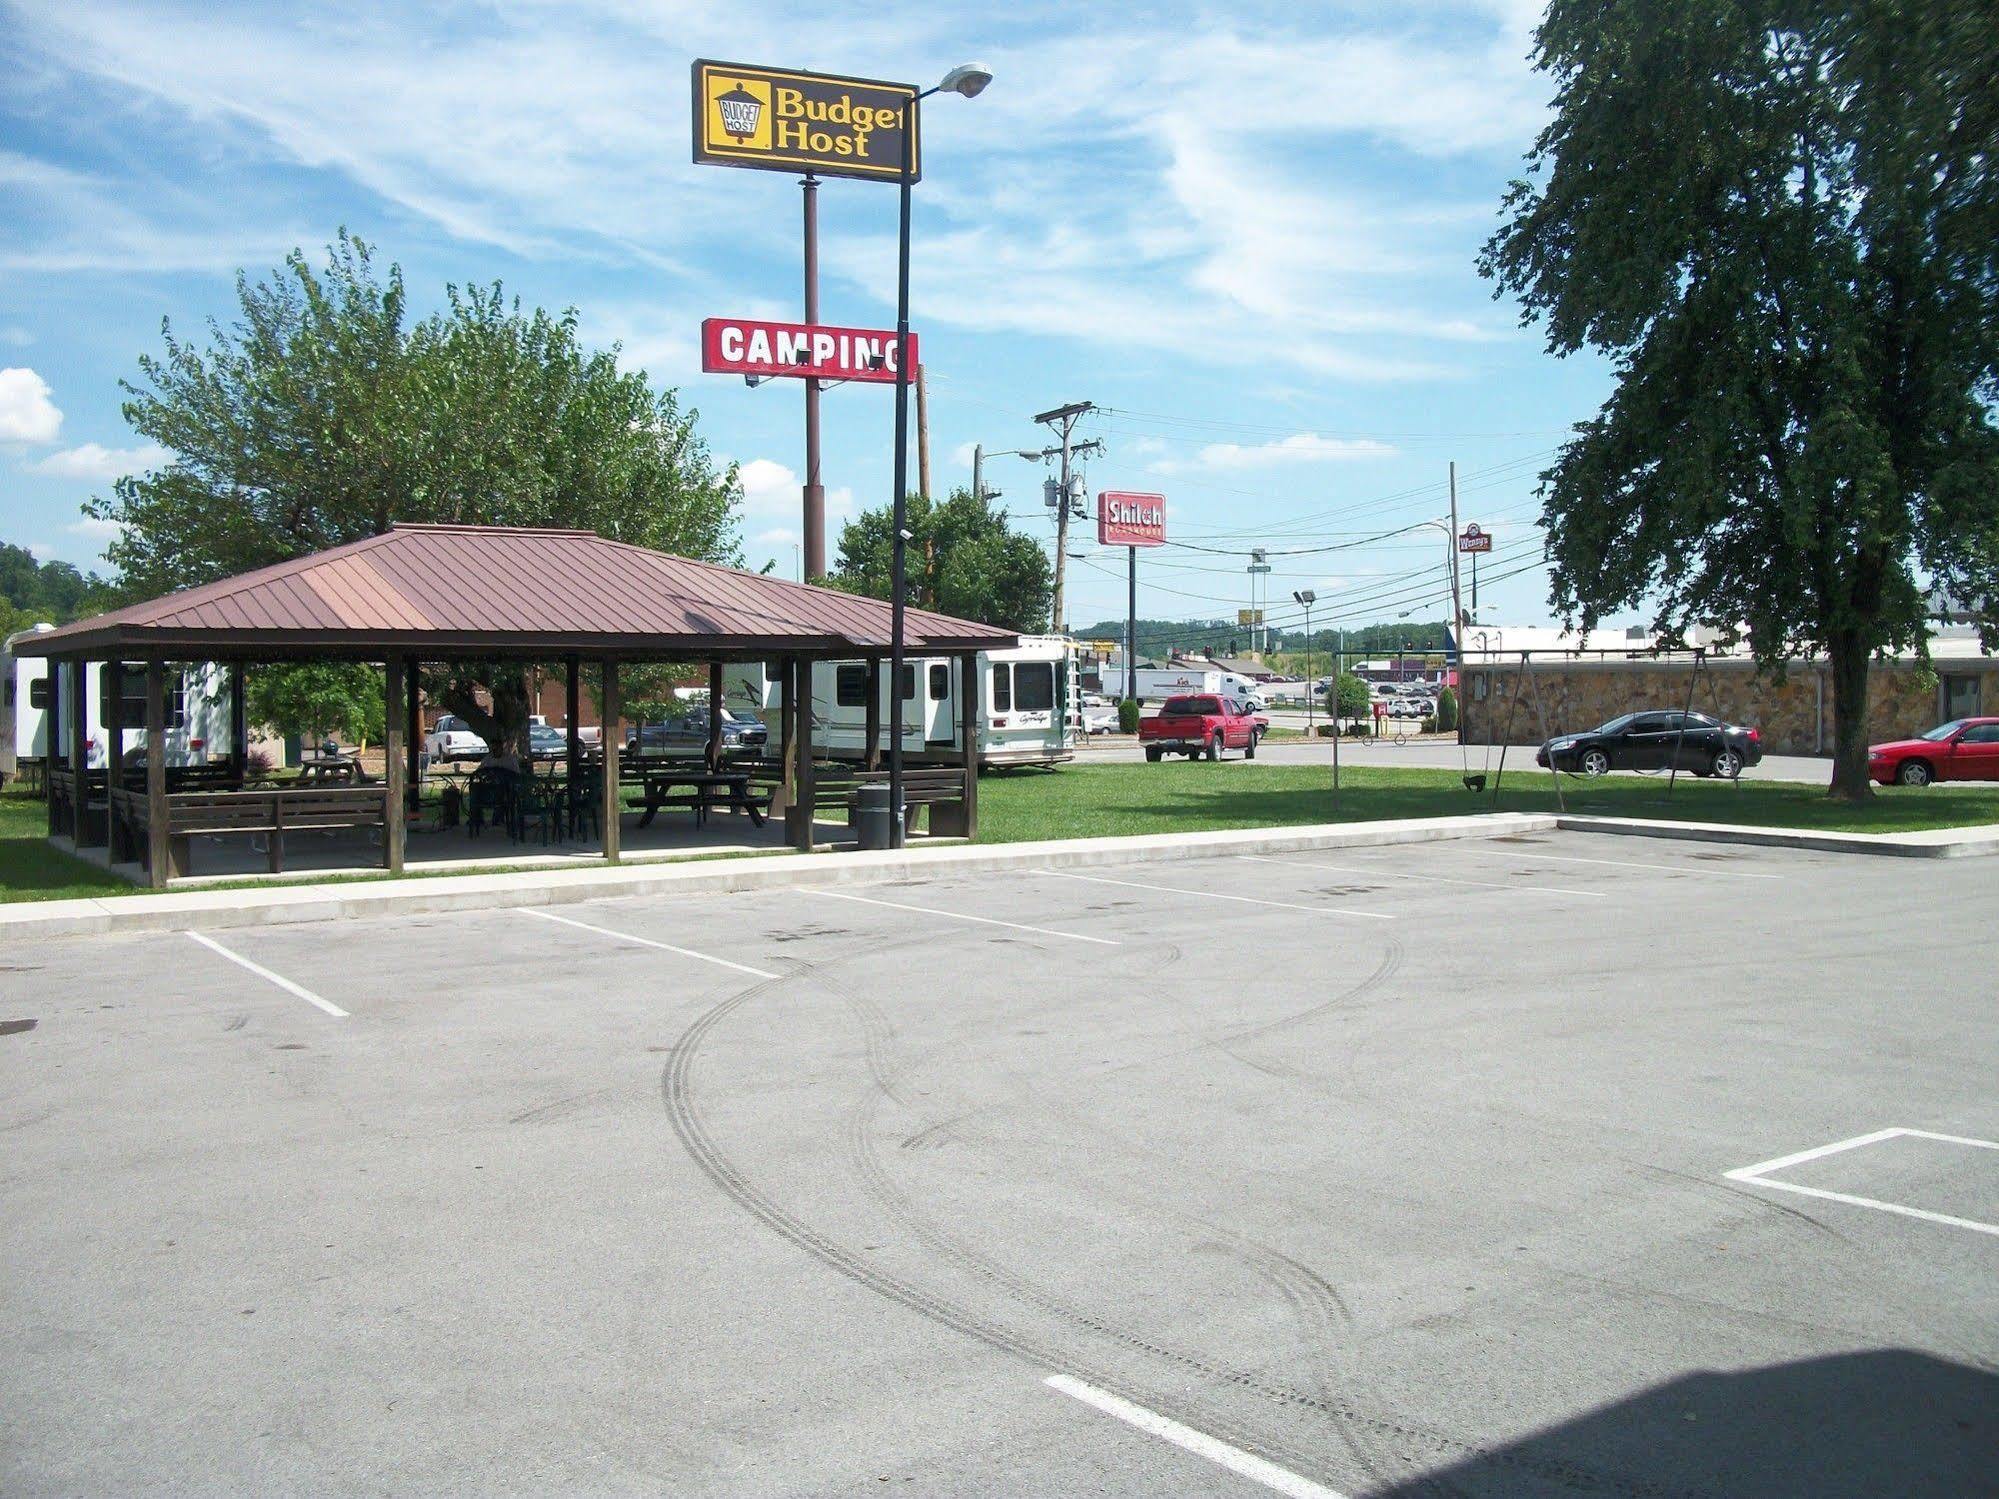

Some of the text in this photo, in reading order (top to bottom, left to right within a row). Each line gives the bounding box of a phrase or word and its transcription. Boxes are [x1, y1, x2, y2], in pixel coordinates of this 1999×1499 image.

[721, 101, 760, 122] BUDGET
[726, 119, 756, 132] HOST
[777, 119, 869, 157] Host
